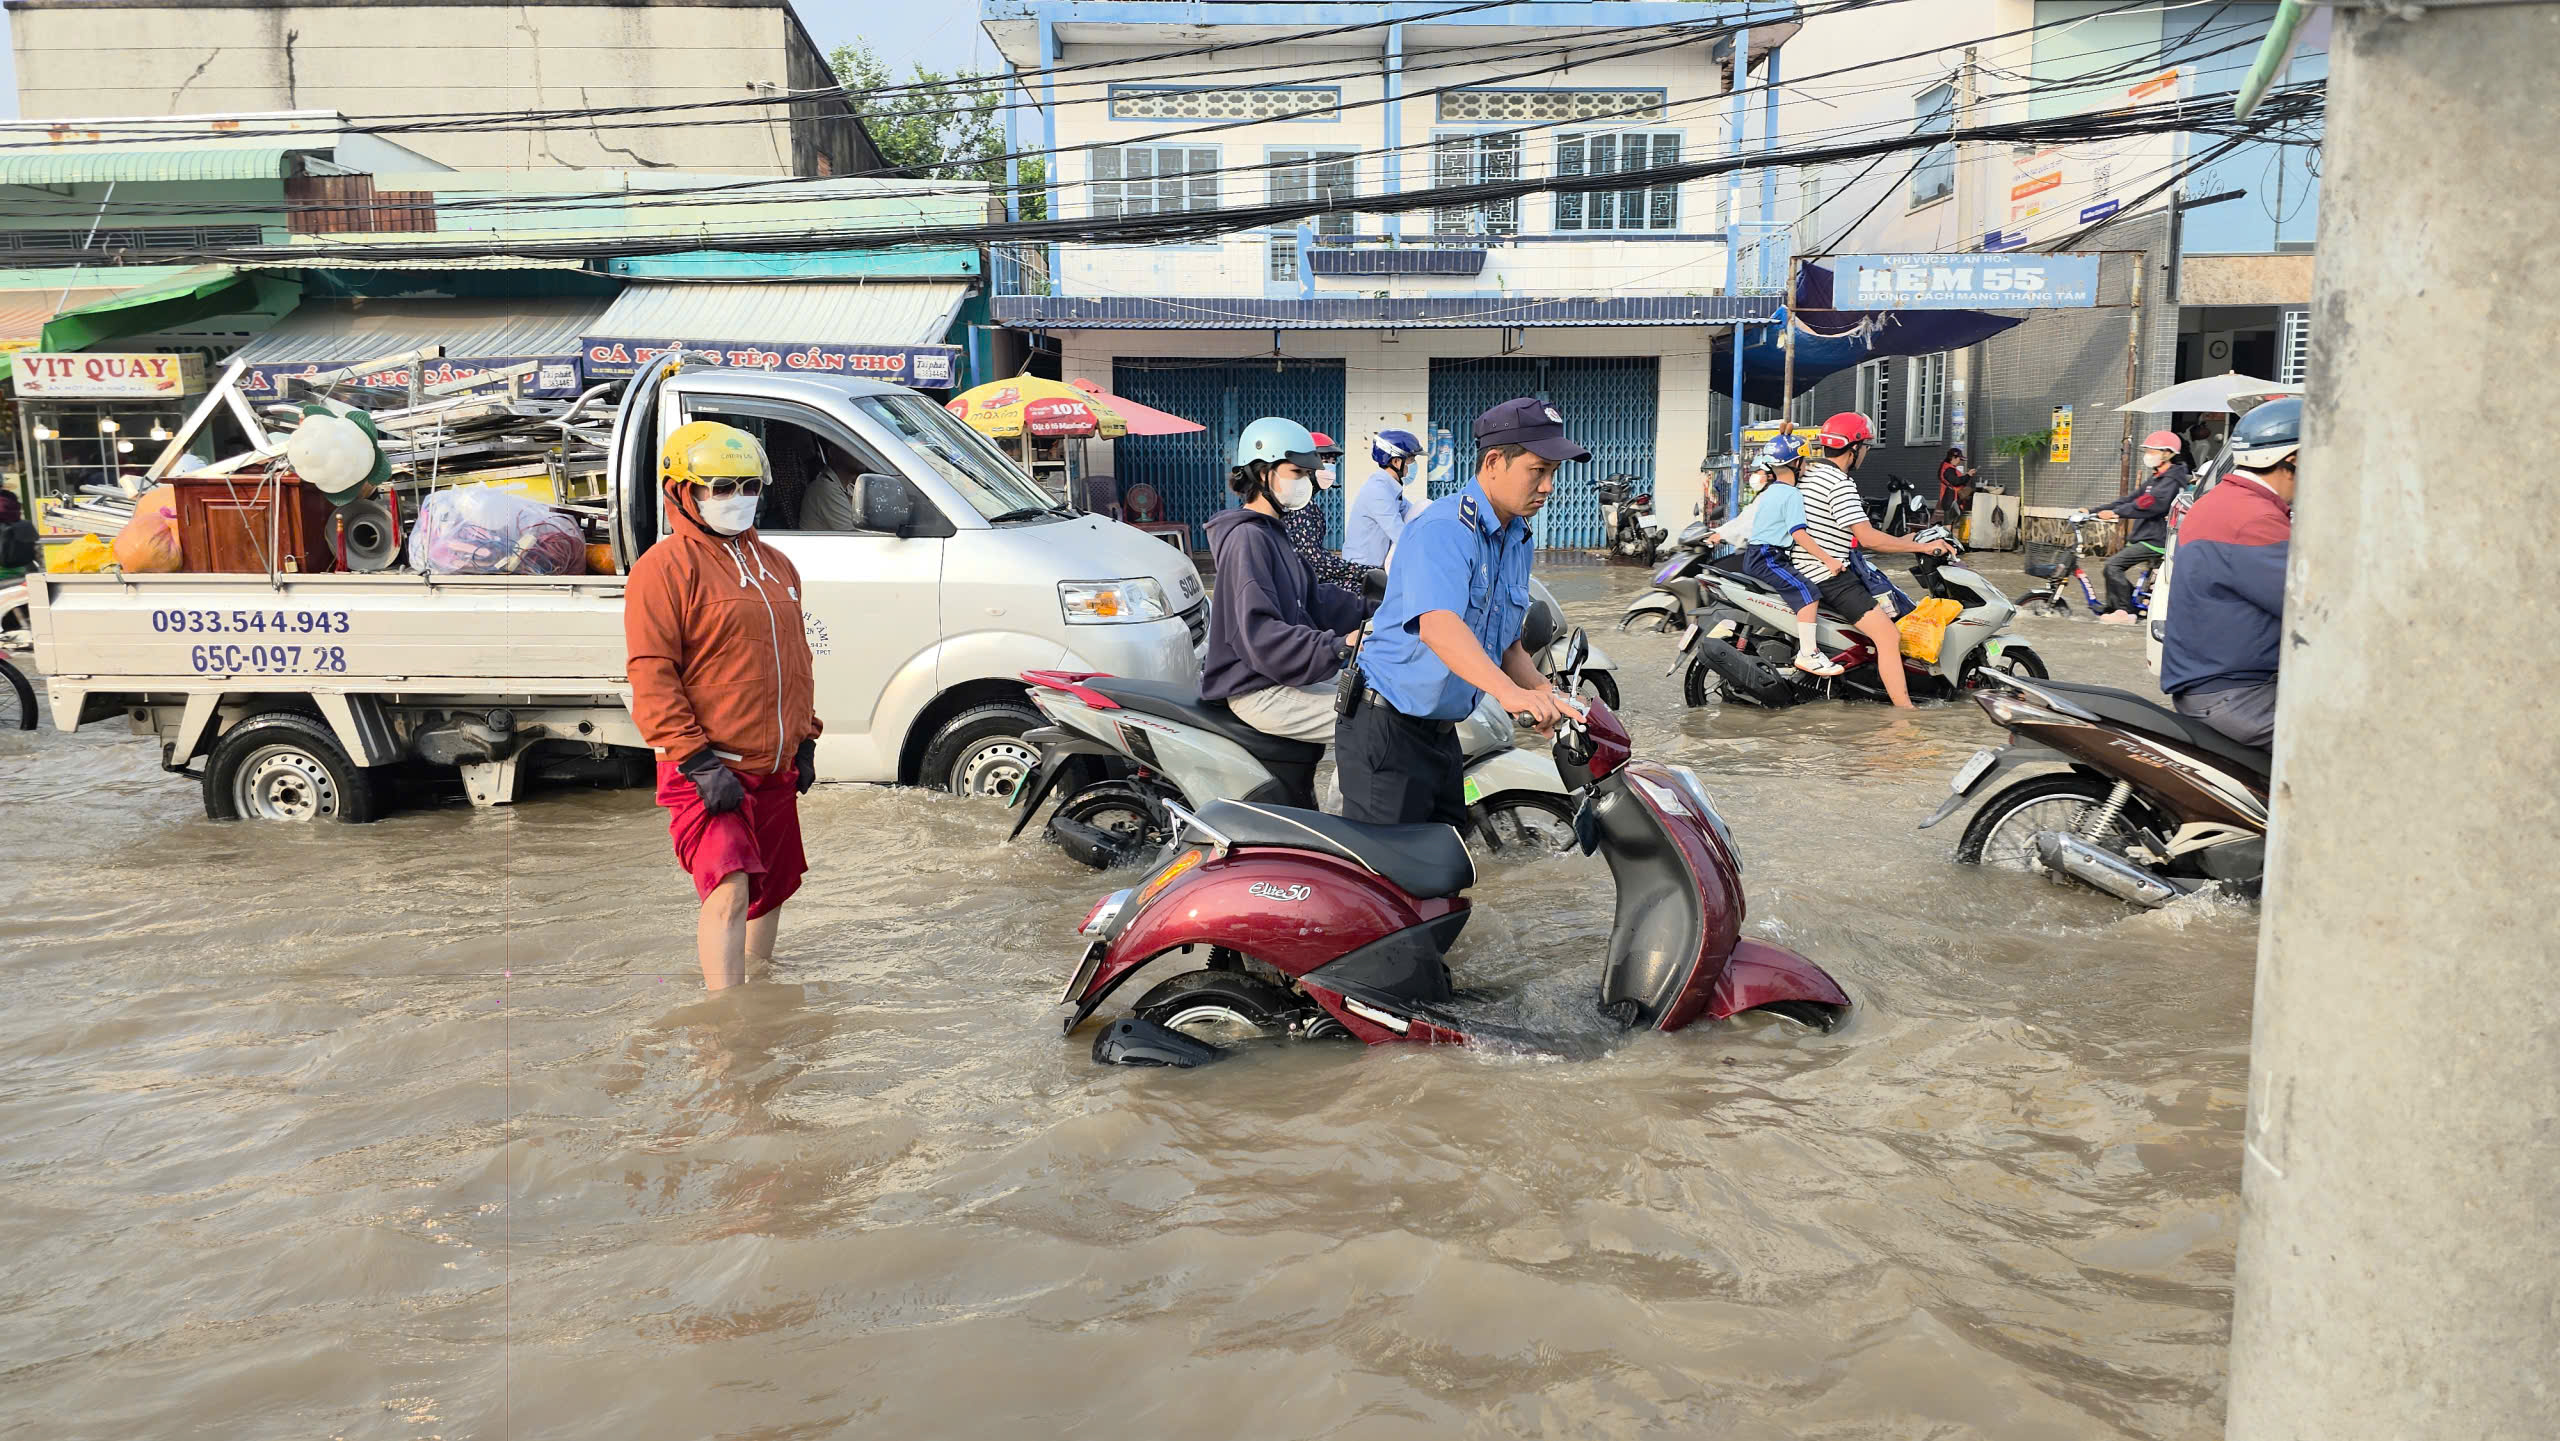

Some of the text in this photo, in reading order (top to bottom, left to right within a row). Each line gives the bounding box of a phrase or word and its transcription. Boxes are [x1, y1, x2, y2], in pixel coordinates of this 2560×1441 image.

[1941, 255, 1949, 265] 2
[1963, 255, 1980, 264] AN
[1983, 267, 2046, 291] 55
[2056, 290, 2086, 301] TÁM
[590, 343, 632, 364] CÁ
[786, 347, 845, 370] CẦN
[849, 352, 906, 371] THƠ
[23, 358, 76, 382] VỊT
[85, 358, 168, 382] QUAY
[1050, 402, 1088, 415] 10K
[1179, 574, 1200, 599] SUZU
[152, 609, 350, 634] 0933.544.943
[191, 645, 347, 673] 65C-097.28
[1337, 692, 1342, 703] 2
